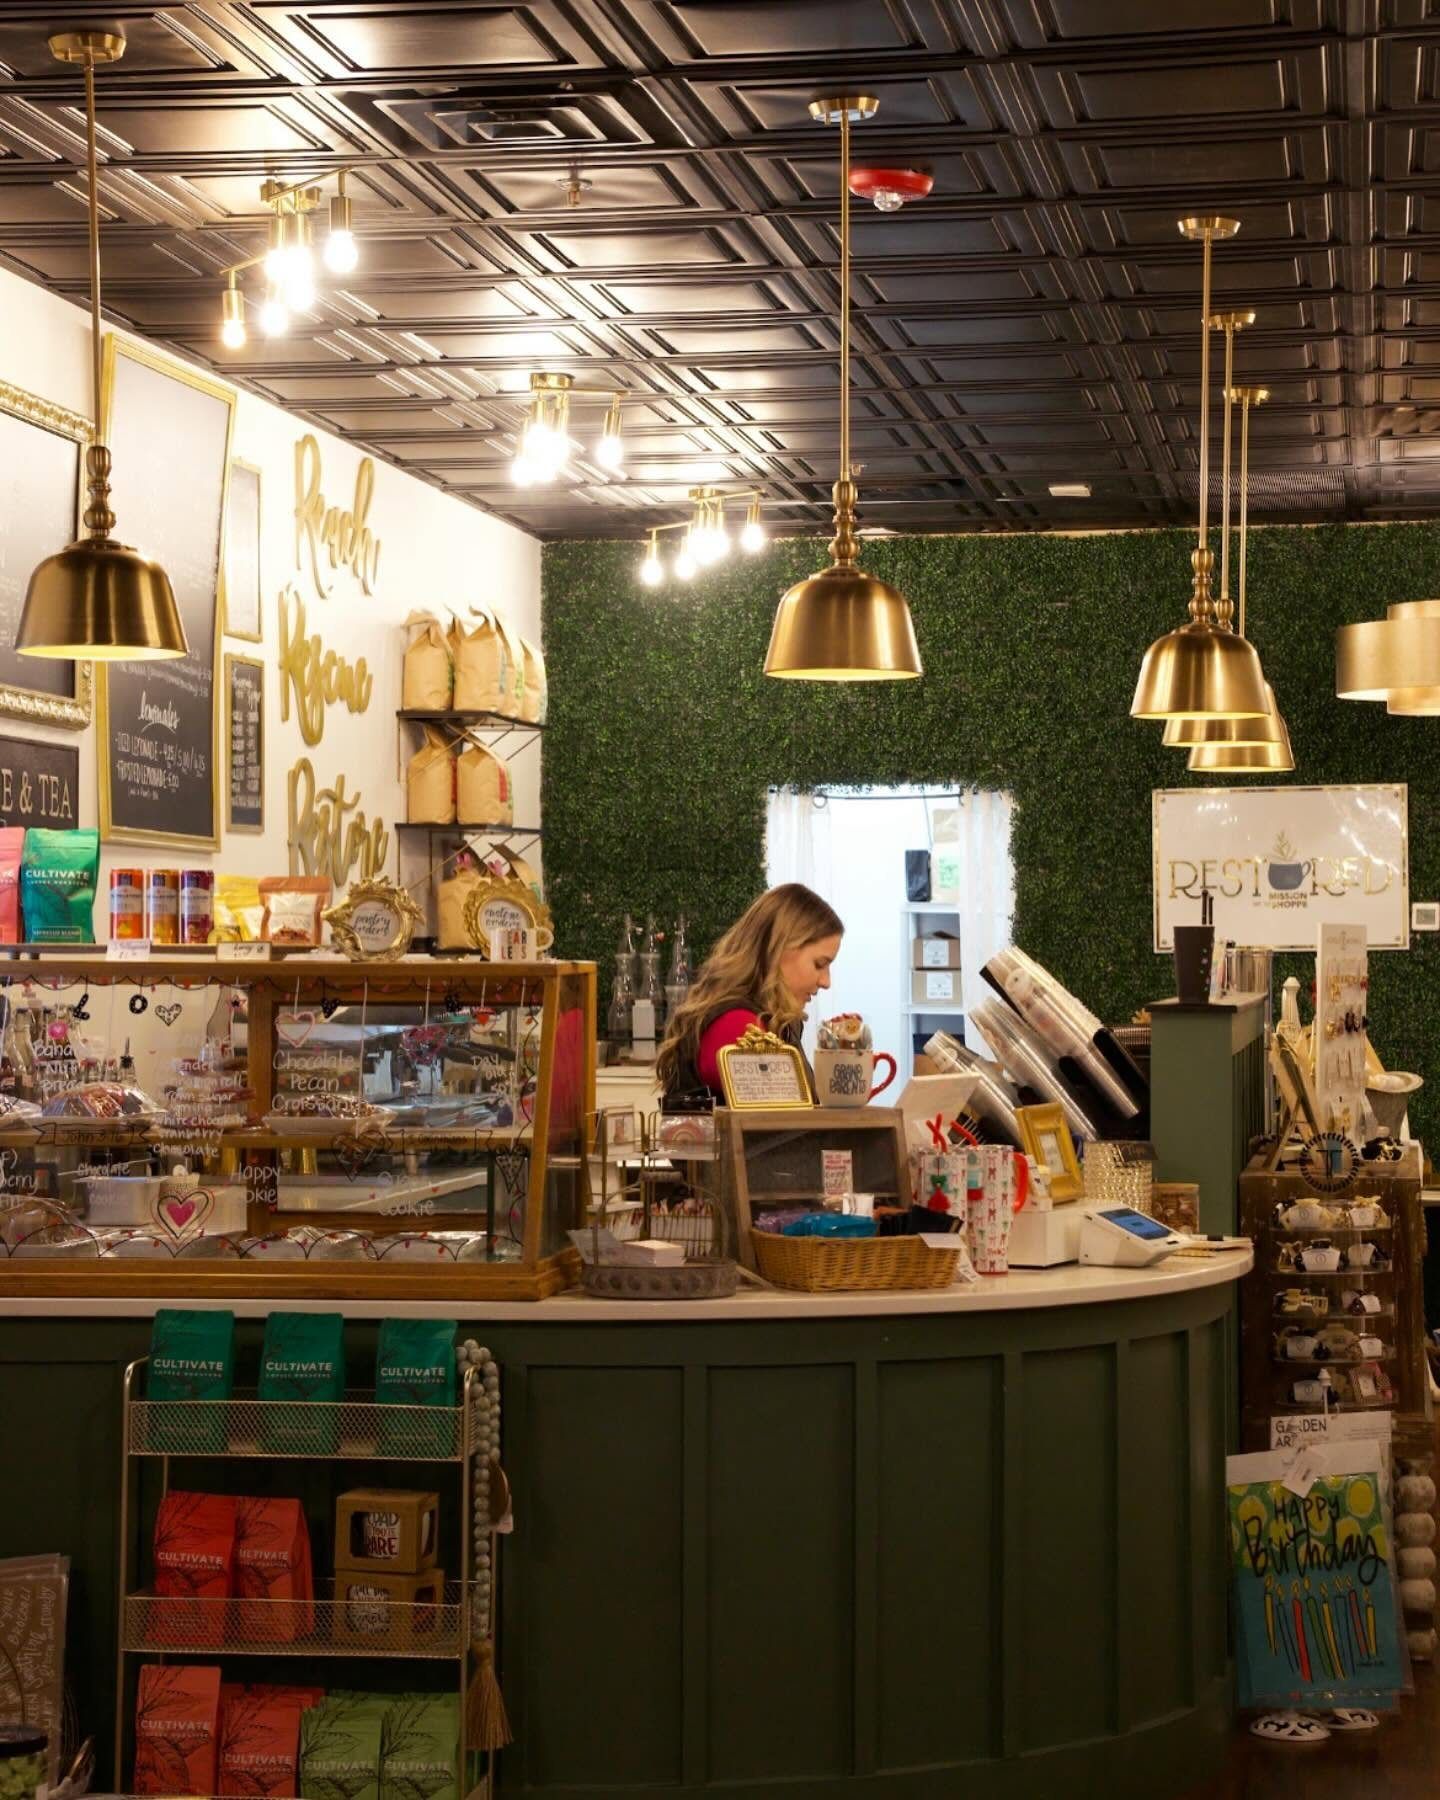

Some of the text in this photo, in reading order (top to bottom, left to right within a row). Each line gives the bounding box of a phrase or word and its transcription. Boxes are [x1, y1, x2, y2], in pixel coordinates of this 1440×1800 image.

[19, 770, 33, 815] &
[38, 774, 73, 819] TEA
[25, 869, 90, 880] CULTIVATE
[1168, 857, 1393, 900] RESTRED
[1268, 892, 1308, 900] MISSION
[501, 945, 527, 960] LES
[272, 1049, 354, 1070] Chocolate
[733, 1061, 792, 1074] RESTRED
[290, 1073, 340, 1092] Pecan
[243, 1186, 278, 1204] okie
[153, 1358, 224, 1371] CULTIVATE
[265, 1361, 333, 1372] CULTIVATE
[380, 1367, 446, 1377] CULTIVATE
[1276, 1417, 1327, 1434] GADEN
[1273, 1495, 1340, 1525] HAPPY
[239, 1549, 289, 1560] ULTIVATE
[1243, 1515, 1387, 1586] Birthday
[158, 1551, 224, 1565] CULTIVATE
[141, 1719, 210, 1731] CULTIVATE
[224, 1753, 293, 1765] CULTIVATE
[305, 1760, 376, 1770] CULTIVATE
[384, 1760, 450, 1771] CULTIVATE
